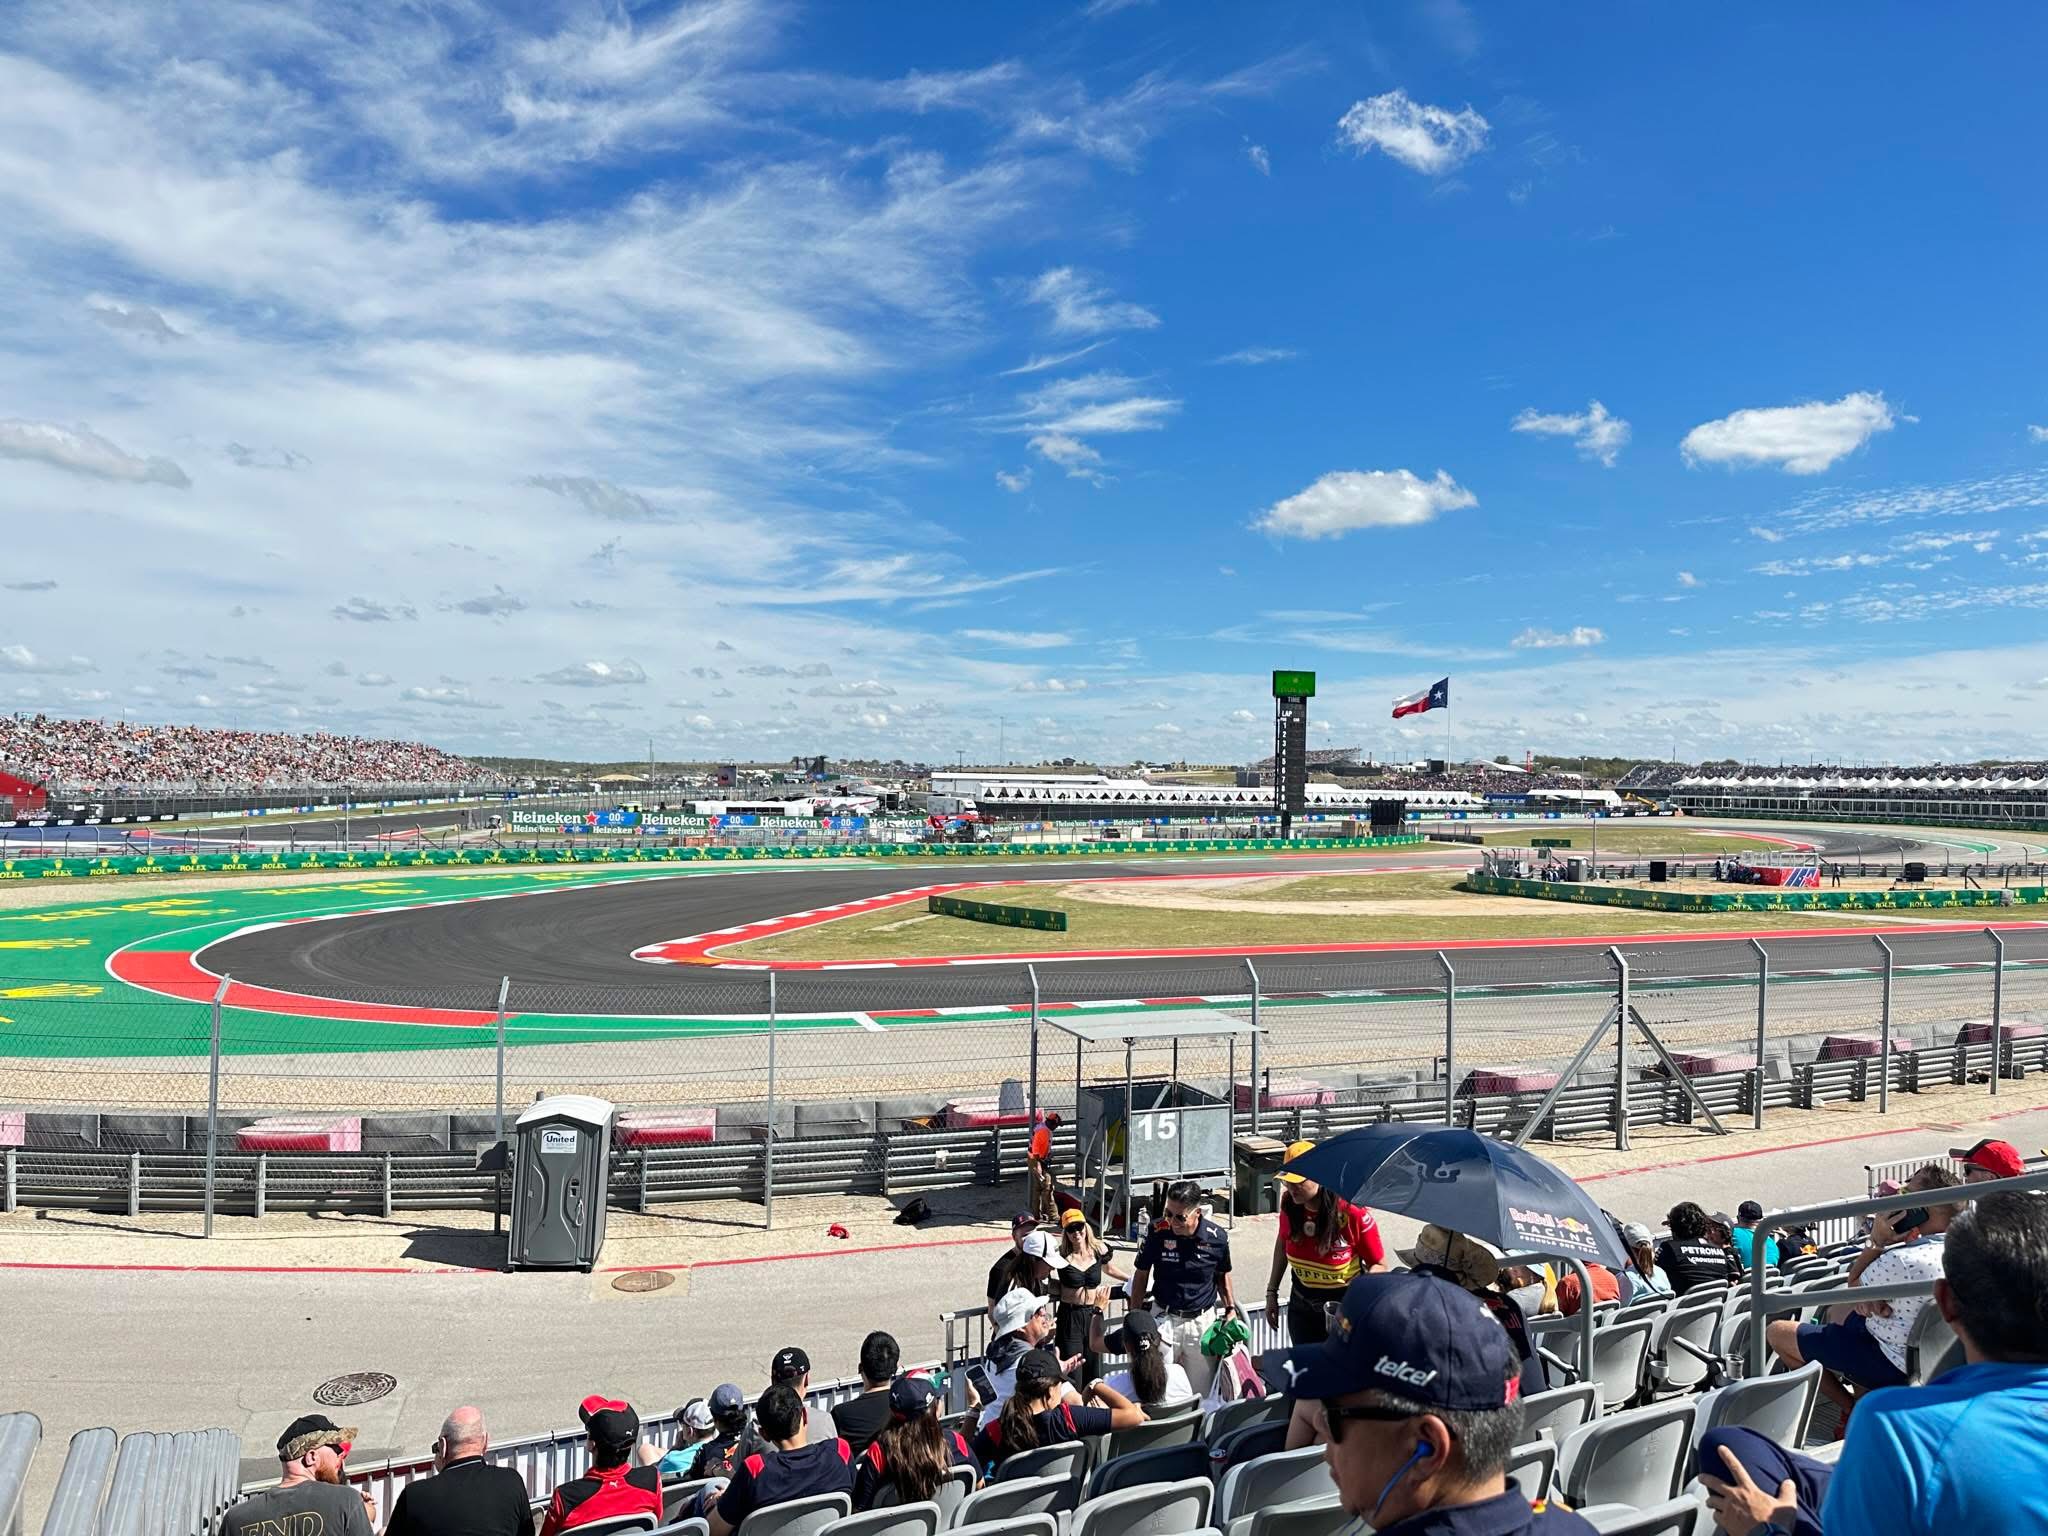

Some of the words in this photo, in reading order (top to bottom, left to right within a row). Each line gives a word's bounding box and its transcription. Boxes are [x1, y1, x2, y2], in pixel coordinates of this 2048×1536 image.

[512, 811, 581, 824] Heineken
[641, 813, 705, 826] Heineken
[760, 816, 817, 829] Heineken
[593, 826, 632, 834] Heineken
[0, 871, 24, 879] OLEX
[43, 869, 72, 877] ROLEX
[90, 868, 120, 876] ROLEX
[180, 864, 206, 872] ROLEX
[1570, 894, 1594, 902] ROLEX
[1607, 898, 1632, 906] ROLEX
[1643, 901, 1667, 909] ROLEX
[1682, 904, 1713, 912] ROLEX
[1767, 903, 1790, 911] ROLEX
[1138, 1113, 1177, 1141] 15
[546, 1135, 575, 1143] United
[1515, 1222, 1597, 1246] RACING
[1520, 1235, 1557, 1246] FORMULA
[1579, 1246, 1600, 1256] TEAM
[1680, 1246, 1726, 1257] PETRONA
[1296, 1268, 1344, 1281] errari
[1373, 1354, 1438, 1387] telcel
